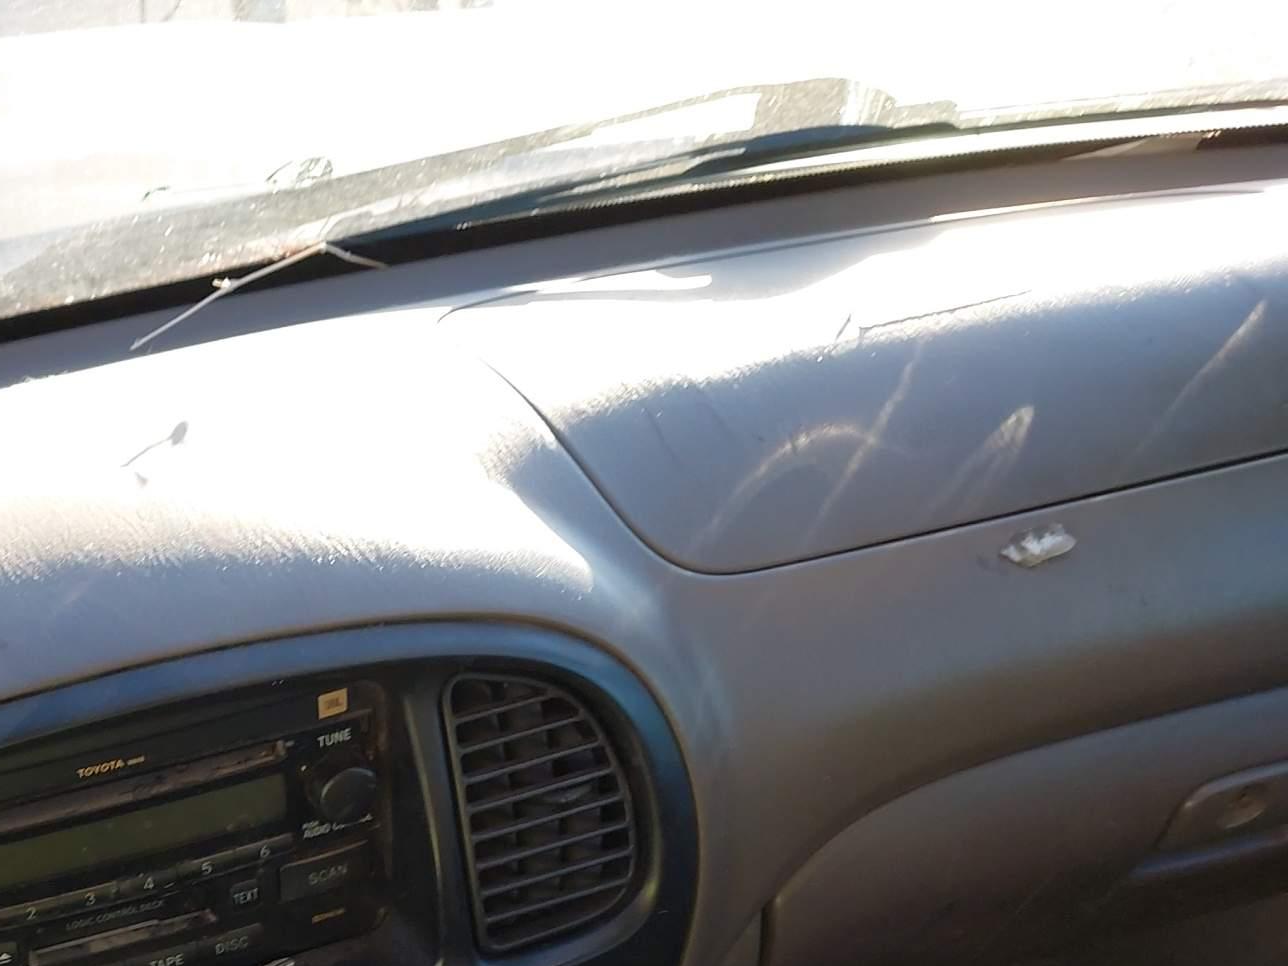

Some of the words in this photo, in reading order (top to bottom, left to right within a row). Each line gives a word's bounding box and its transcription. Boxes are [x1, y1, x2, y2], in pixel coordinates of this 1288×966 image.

[316, 727, 352, 749] TUNE
[75, 758, 125, 779] TOYOTA
[259, 846, 271, 859] 6
[200, 861, 213, 875] 5
[308, 863, 349, 886] SCAN
[143, 877, 155, 890] 4
[86, 892, 97, 905] 3
[232, 887, 259, 904] TEXT
[26, 907, 39, 920] 2
[215, 936, 249, 956] DISC
